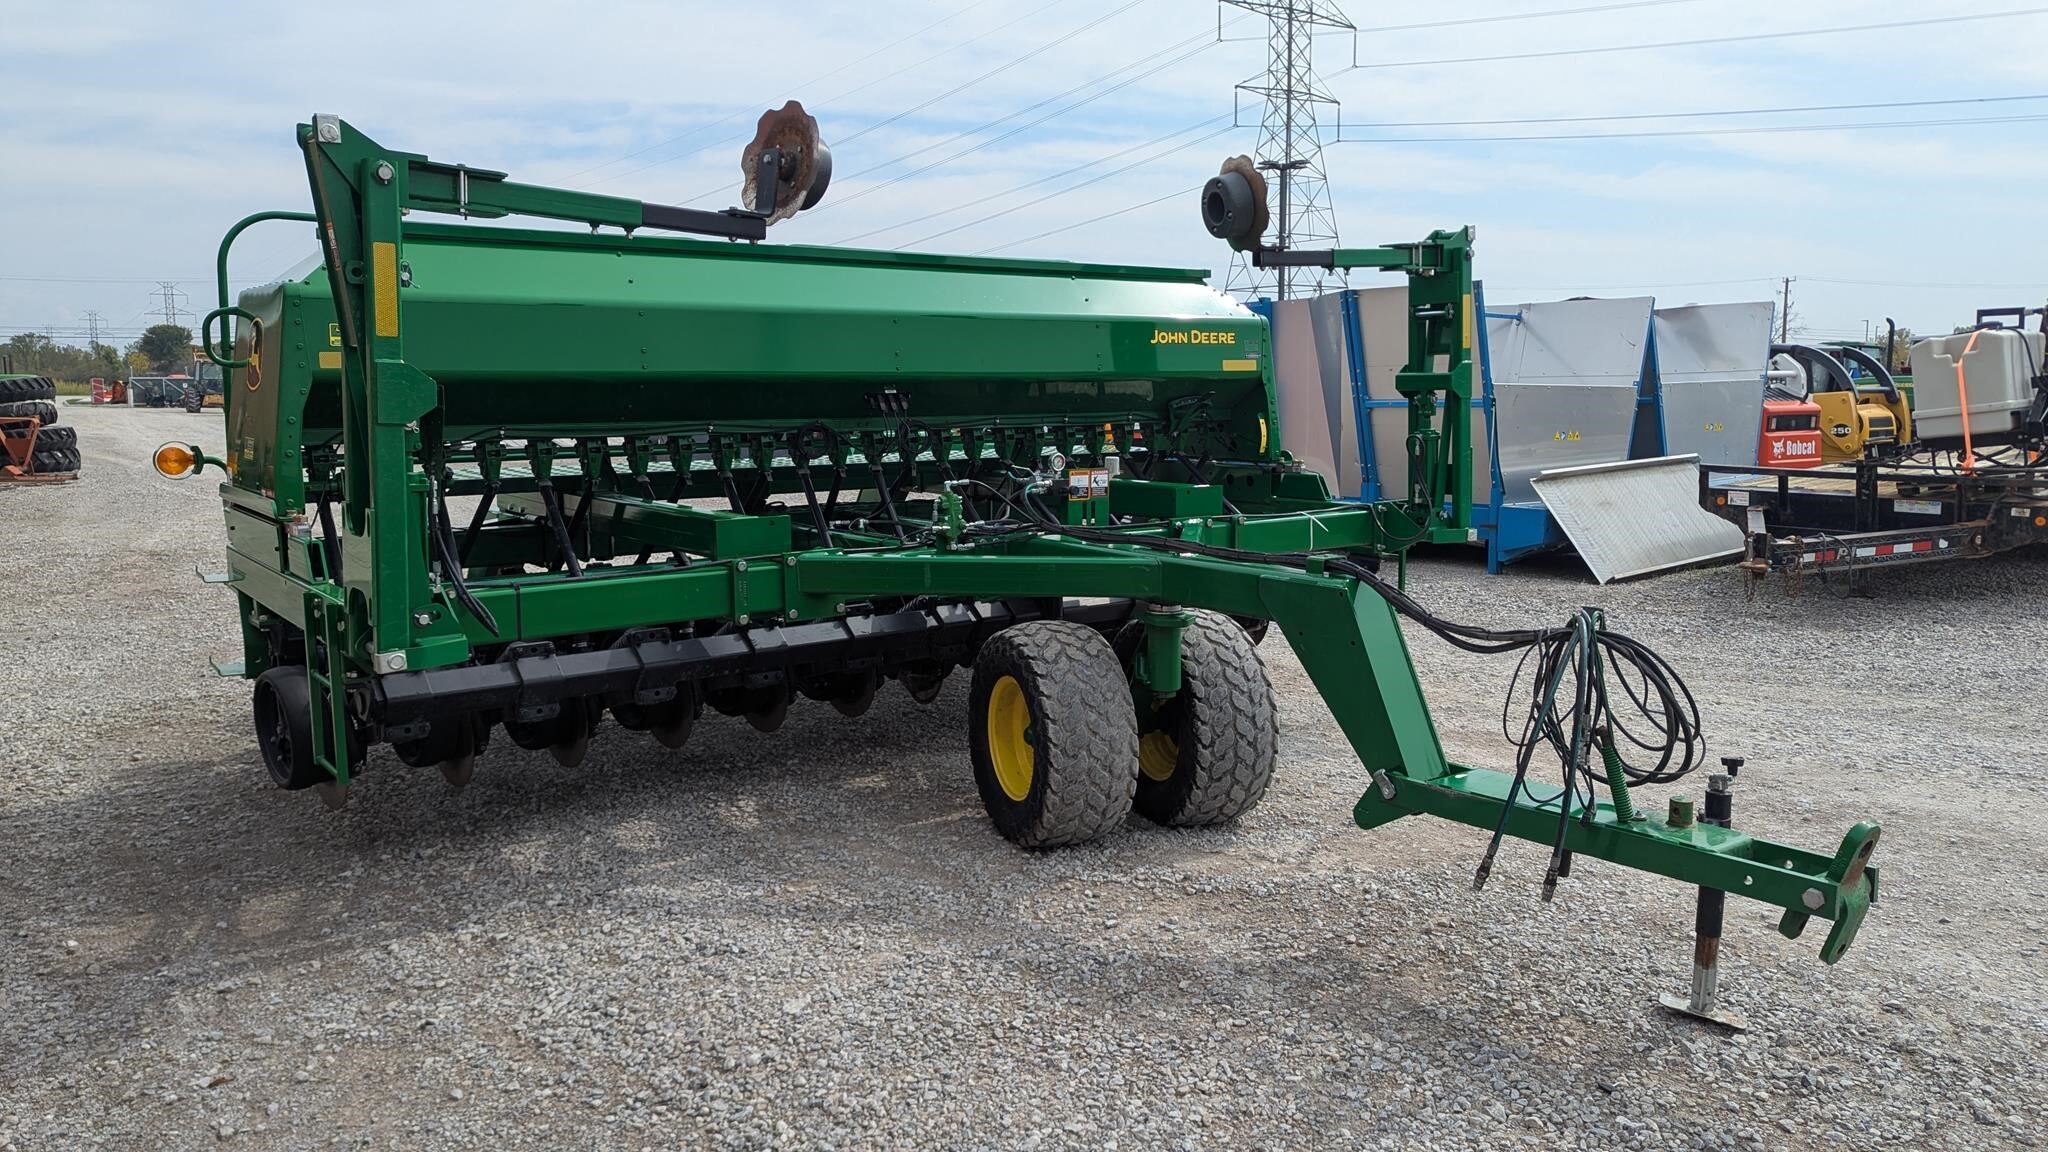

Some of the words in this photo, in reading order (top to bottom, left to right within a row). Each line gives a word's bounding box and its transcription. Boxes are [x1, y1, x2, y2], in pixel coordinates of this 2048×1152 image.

[1150, 330, 1188, 344] JOHN
[1191, 330, 1235, 344] DEERE
[1786, 440, 1816, 455] Bobcat
